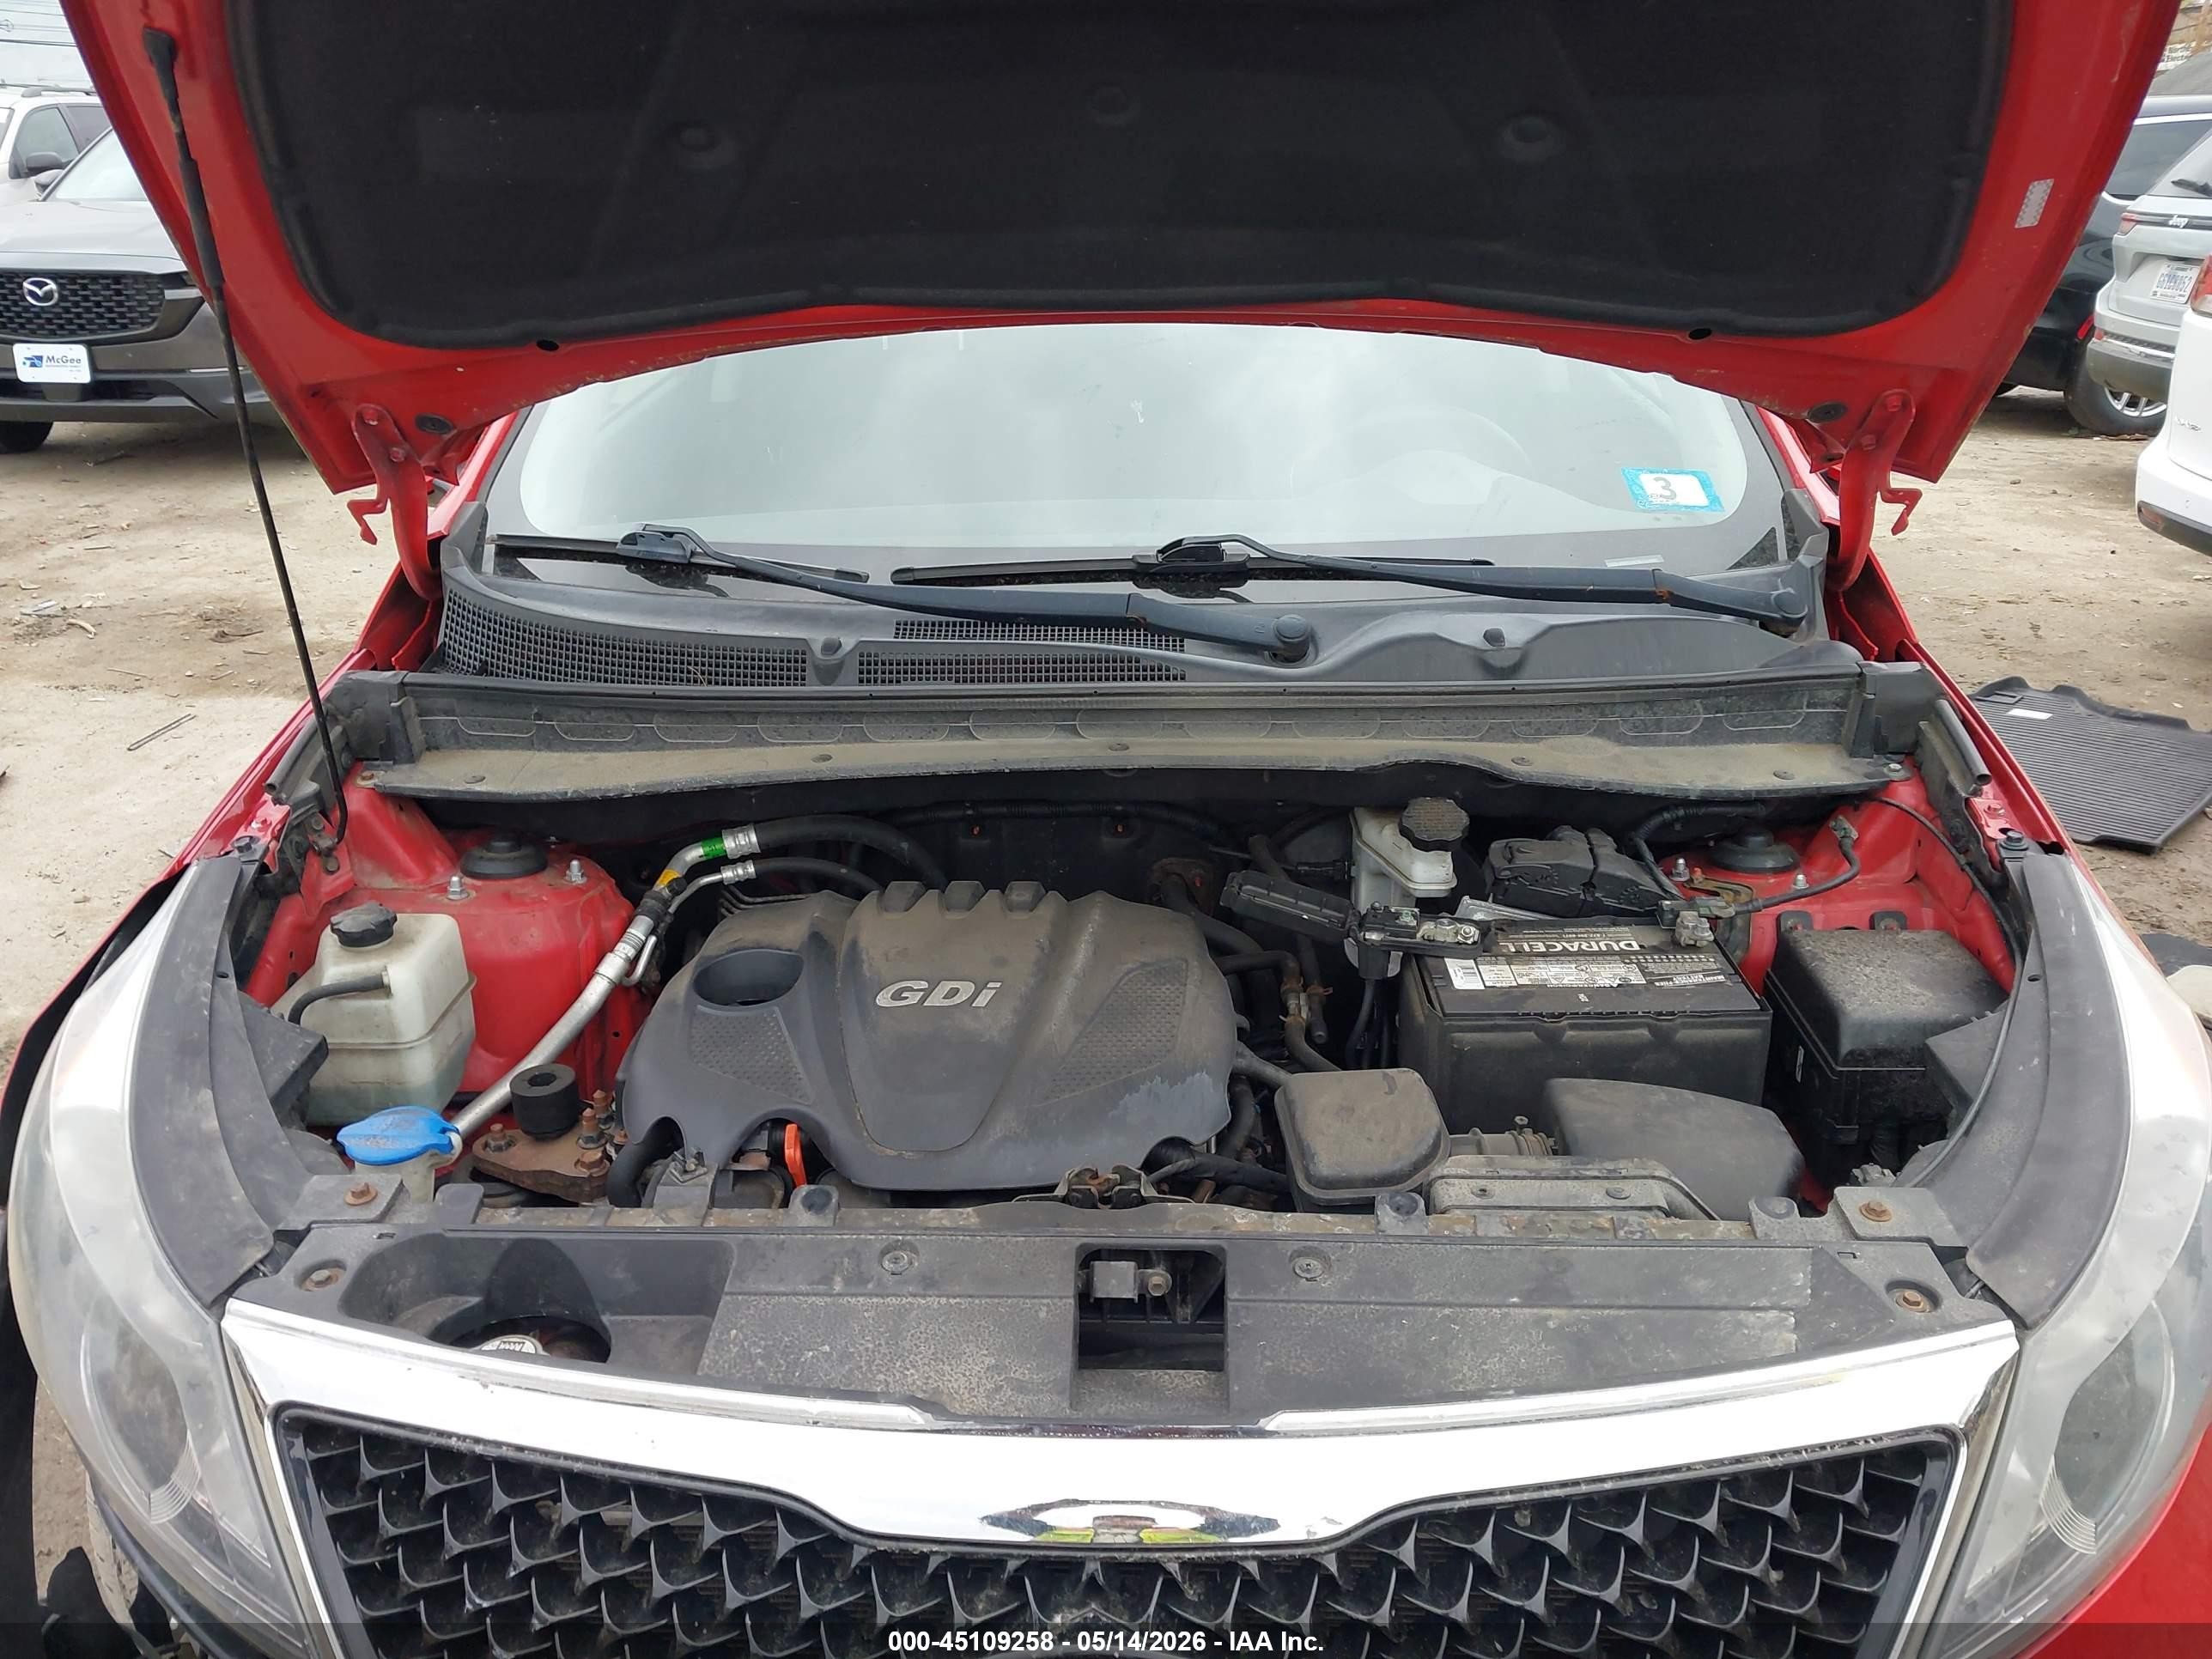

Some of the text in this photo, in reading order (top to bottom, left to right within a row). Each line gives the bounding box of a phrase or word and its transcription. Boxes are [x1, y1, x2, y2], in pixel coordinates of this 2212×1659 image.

[46, 355, 82, 363] McGee
[1653, 477, 1677, 500] 3
[1499, 940, 1640, 952] DURACELL
[876, 980, 1003, 1007] GDi
